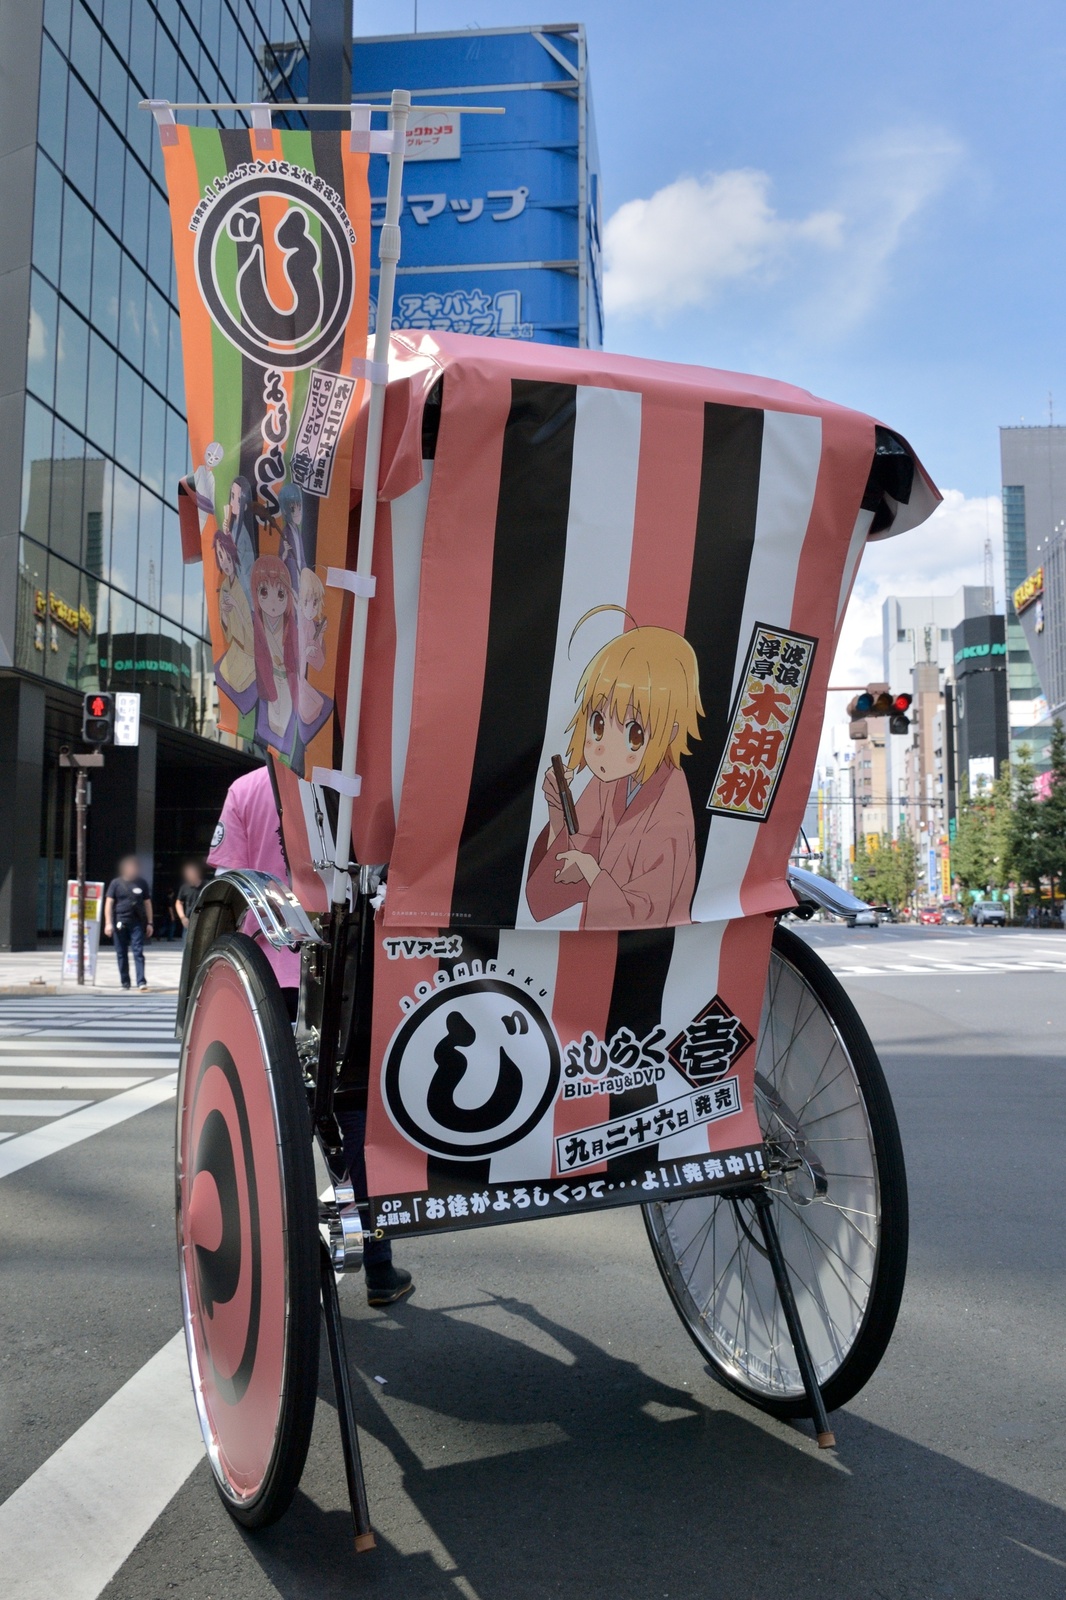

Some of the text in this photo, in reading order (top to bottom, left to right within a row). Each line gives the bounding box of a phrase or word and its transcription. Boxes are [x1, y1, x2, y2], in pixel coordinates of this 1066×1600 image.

[407, 137, 440, 147] グループ
[750, 636, 782, 680] 浮亭
[773, 642, 806, 688] 波浪
[716, 683, 793, 812] 木胡桃
[386, 938, 461, 956] TVアニメ
[404, 963, 549, 1009] JOSHIRAKU
[426, 1010, 529, 1133] じ
[564, 1086, 732, 1167] 九月二十六日 発売
[375, 1210, 412, 1227] 主題歌
[381, 1199, 403, 1213] OP
